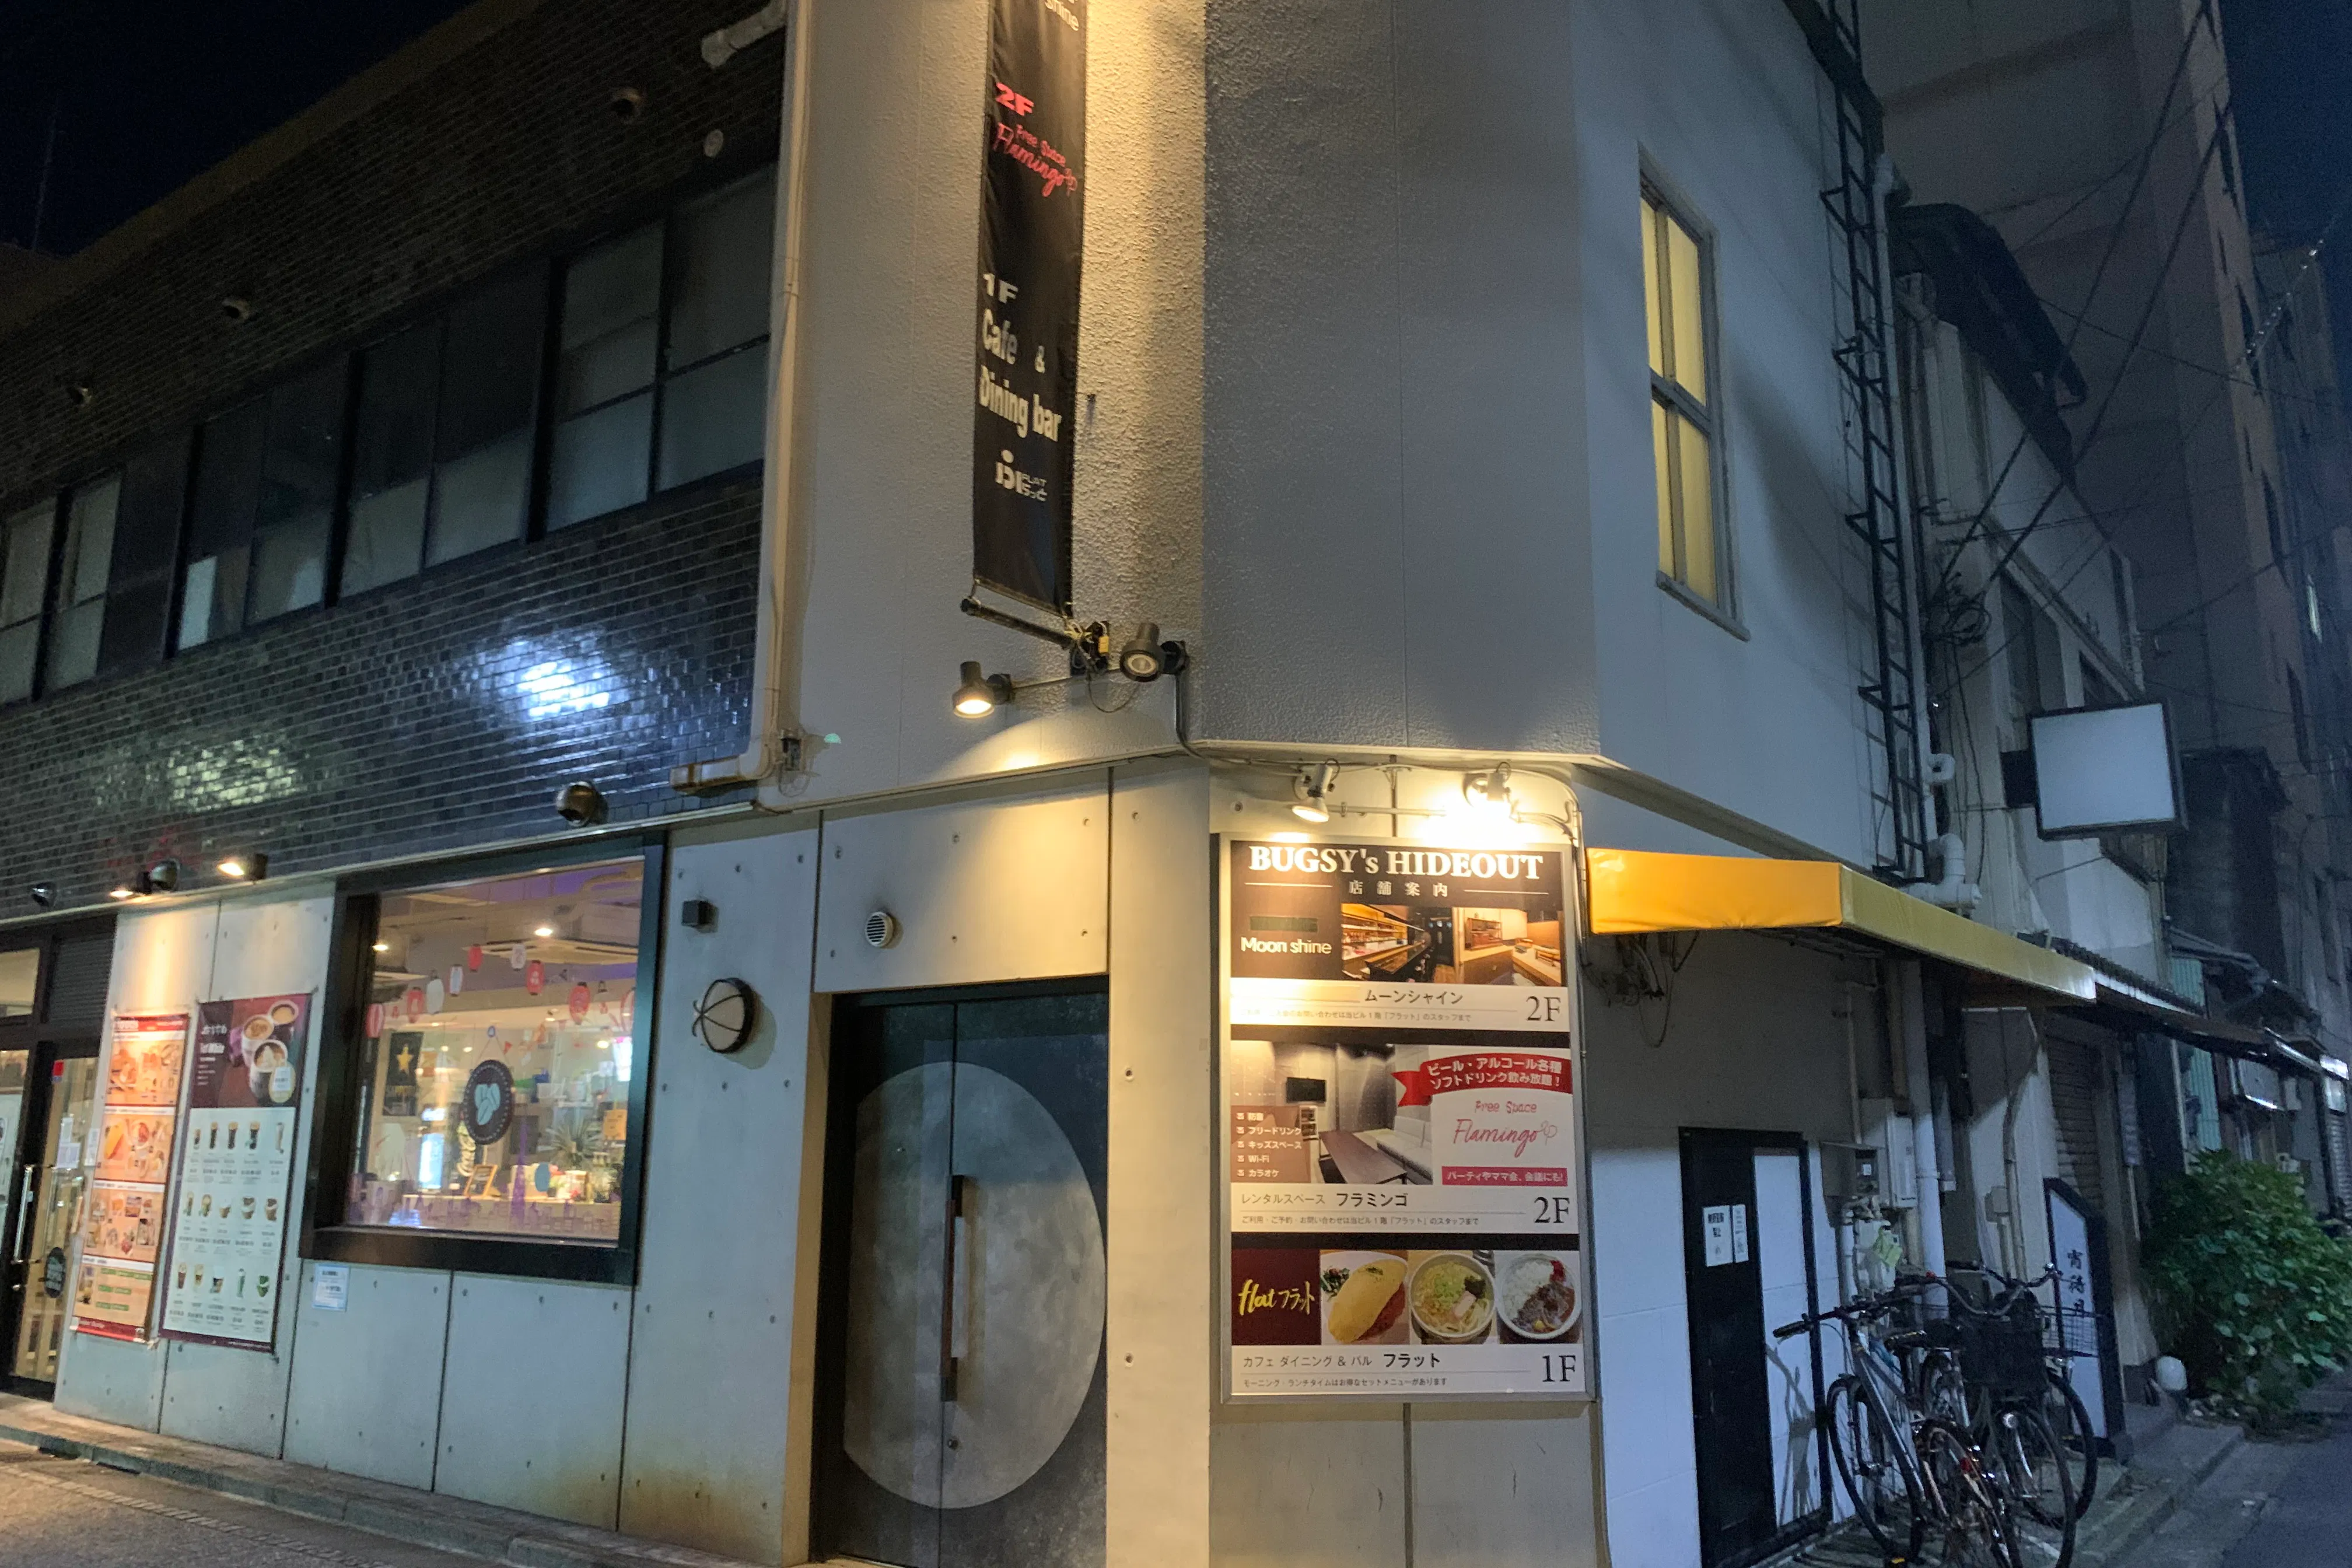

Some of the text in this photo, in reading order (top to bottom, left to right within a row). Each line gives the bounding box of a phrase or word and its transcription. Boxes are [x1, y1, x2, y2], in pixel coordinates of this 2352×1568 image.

[996, 82, 1034, 116] 2F
[983, 273, 1019, 304] 1F
[982, 308, 1045, 373] Cafe &
[979, 365, 1062, 442] Dining bar
[1248, 846, 1543, 879] BUGSY's HIDEOUT
[1348, 880, 1448, 898] 店舗案内
[1241, 937, 1332, 954] Moon shine
[1365, 989, 1464, 1005] ムーンシャイン
[1526, 996, 1562, 1021] 2F
[1475, 1100, 1537, 1114] Free Space
[1248, 1126, 1301, 1135] フリードリンク
[1453, 1119, 1539, 1158] Flamingo
[1248, 1140, 1302, 1149] キッズスペース
[1248, 1155, 1270, 1163] Wi-Fi
[1248, 1169, 1279, 1177] カラオケ
[1241, 1192, 1408, 1207] レンタルスペース フラミンゴ
[1534, 1196, 1570, 1223] 2F
[1238, 1279, 1315, 1316] flat フラット
[1243, 1353, 1441, 1368] カフェ ダイニング & バル フラット
[1542, 1355, 1576, 1382] 1F
